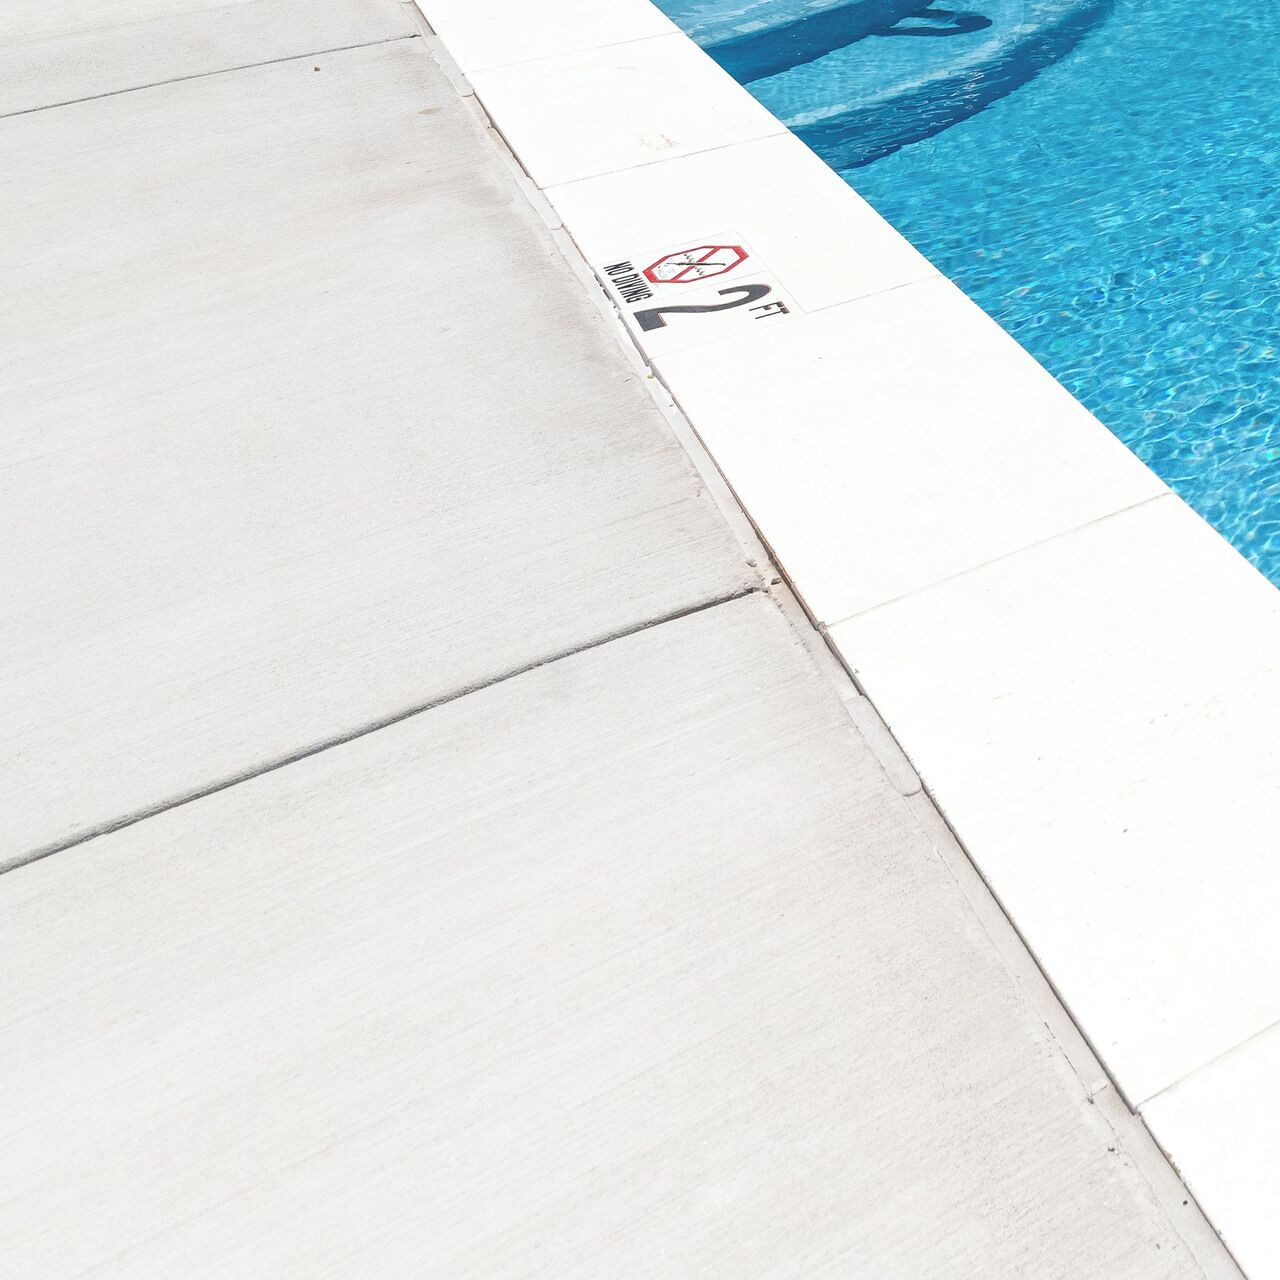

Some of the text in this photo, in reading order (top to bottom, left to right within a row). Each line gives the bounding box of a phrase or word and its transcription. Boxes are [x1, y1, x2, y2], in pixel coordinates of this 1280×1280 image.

[603, 261, 653, 303] NO DIVING
[633, 284, 790, 332] 2 FT
